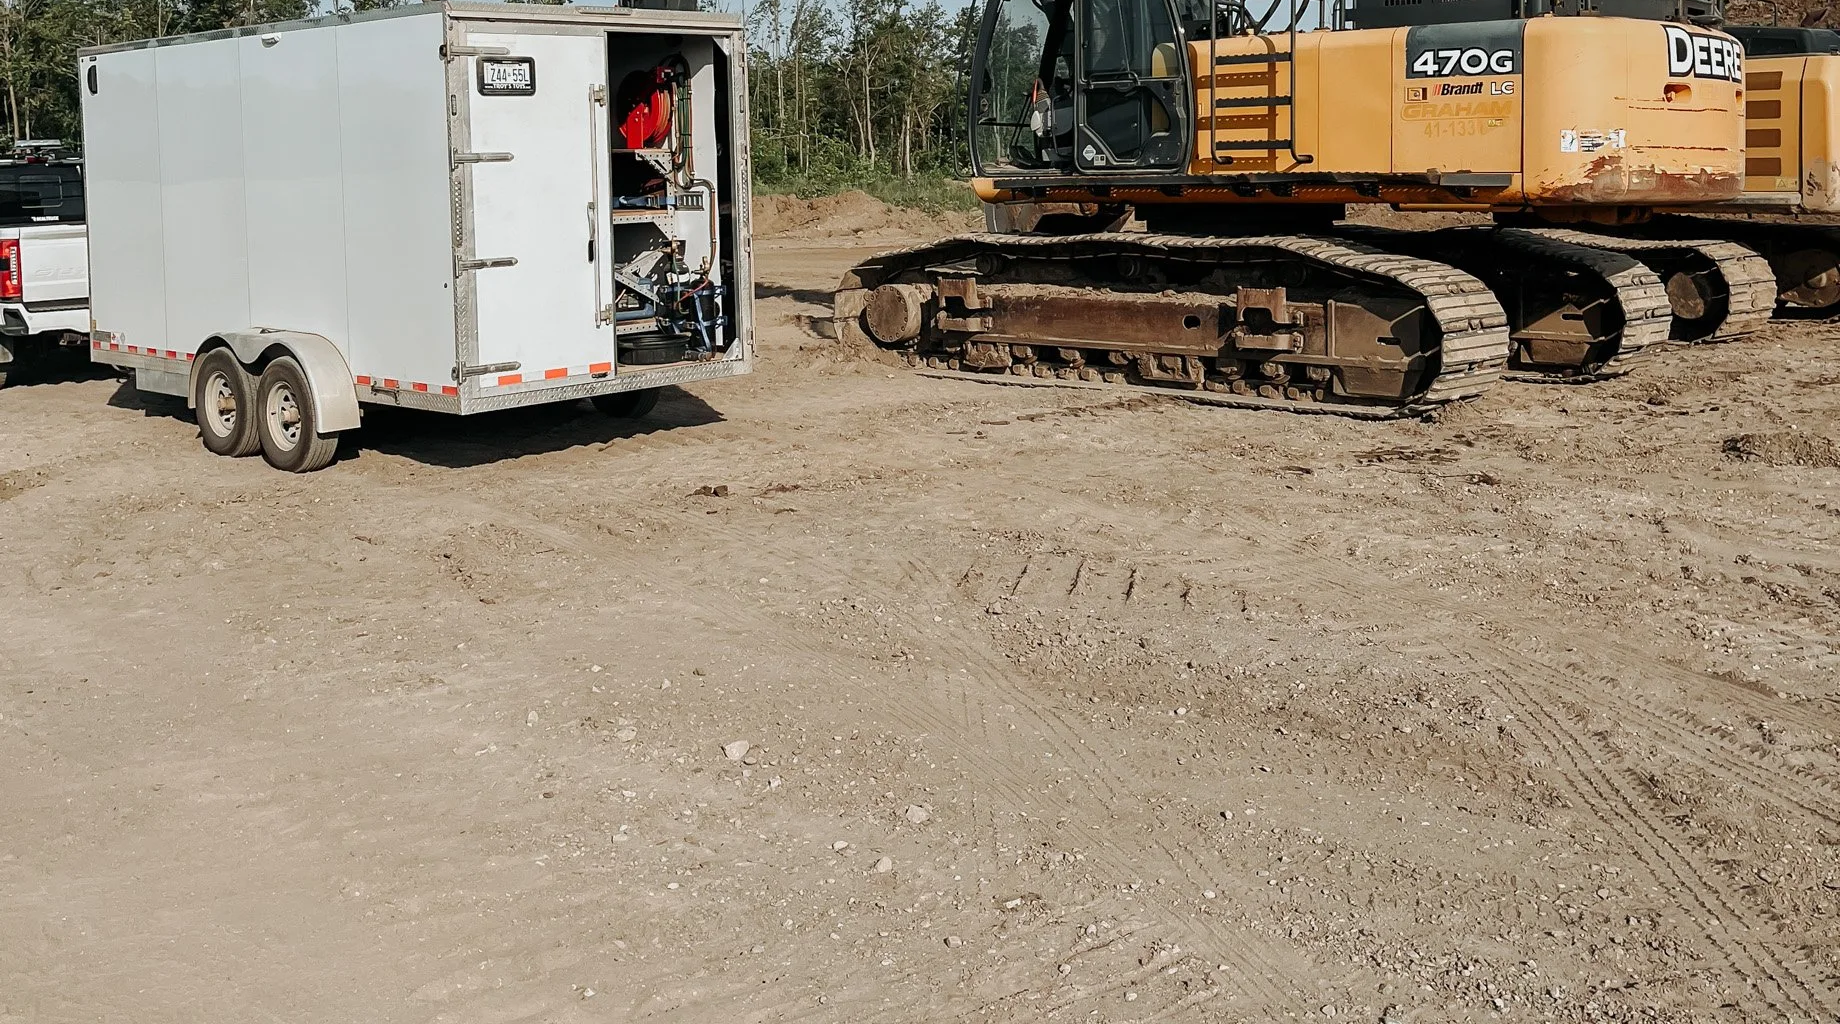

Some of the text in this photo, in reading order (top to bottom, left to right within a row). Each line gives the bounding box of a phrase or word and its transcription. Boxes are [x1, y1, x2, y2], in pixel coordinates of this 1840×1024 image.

[1412, 47, 1515, 76] 470G
[1664, 25, 1742, 81] DEERE
[1440, 81, 1515, 95] Brandt LC
[1402, 101, 1512, 118] GRAHAM
